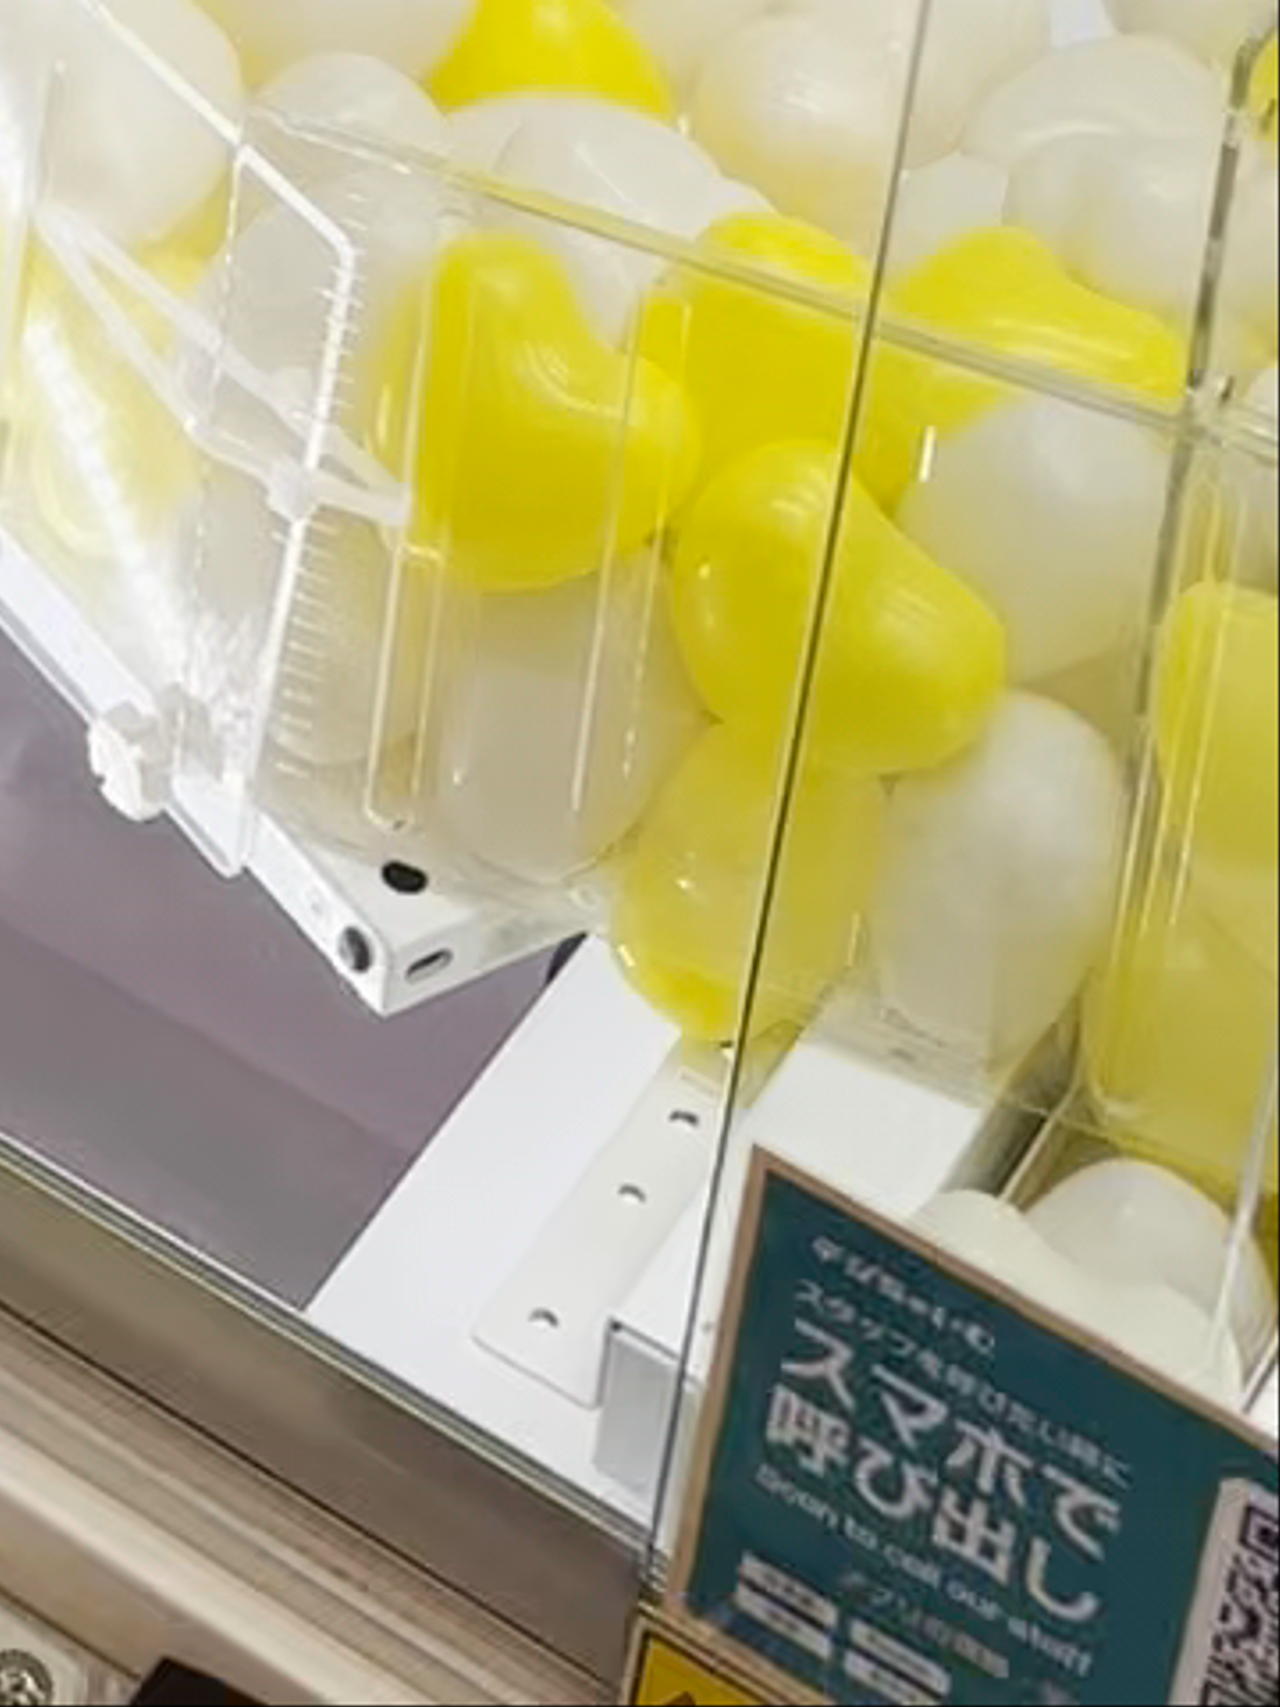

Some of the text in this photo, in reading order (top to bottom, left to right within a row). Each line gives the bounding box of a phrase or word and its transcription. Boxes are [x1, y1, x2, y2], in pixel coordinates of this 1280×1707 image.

[763, 1387, 1104, 1631] 呼び出し
[781, 1317, 1122, 1561] スマホで
